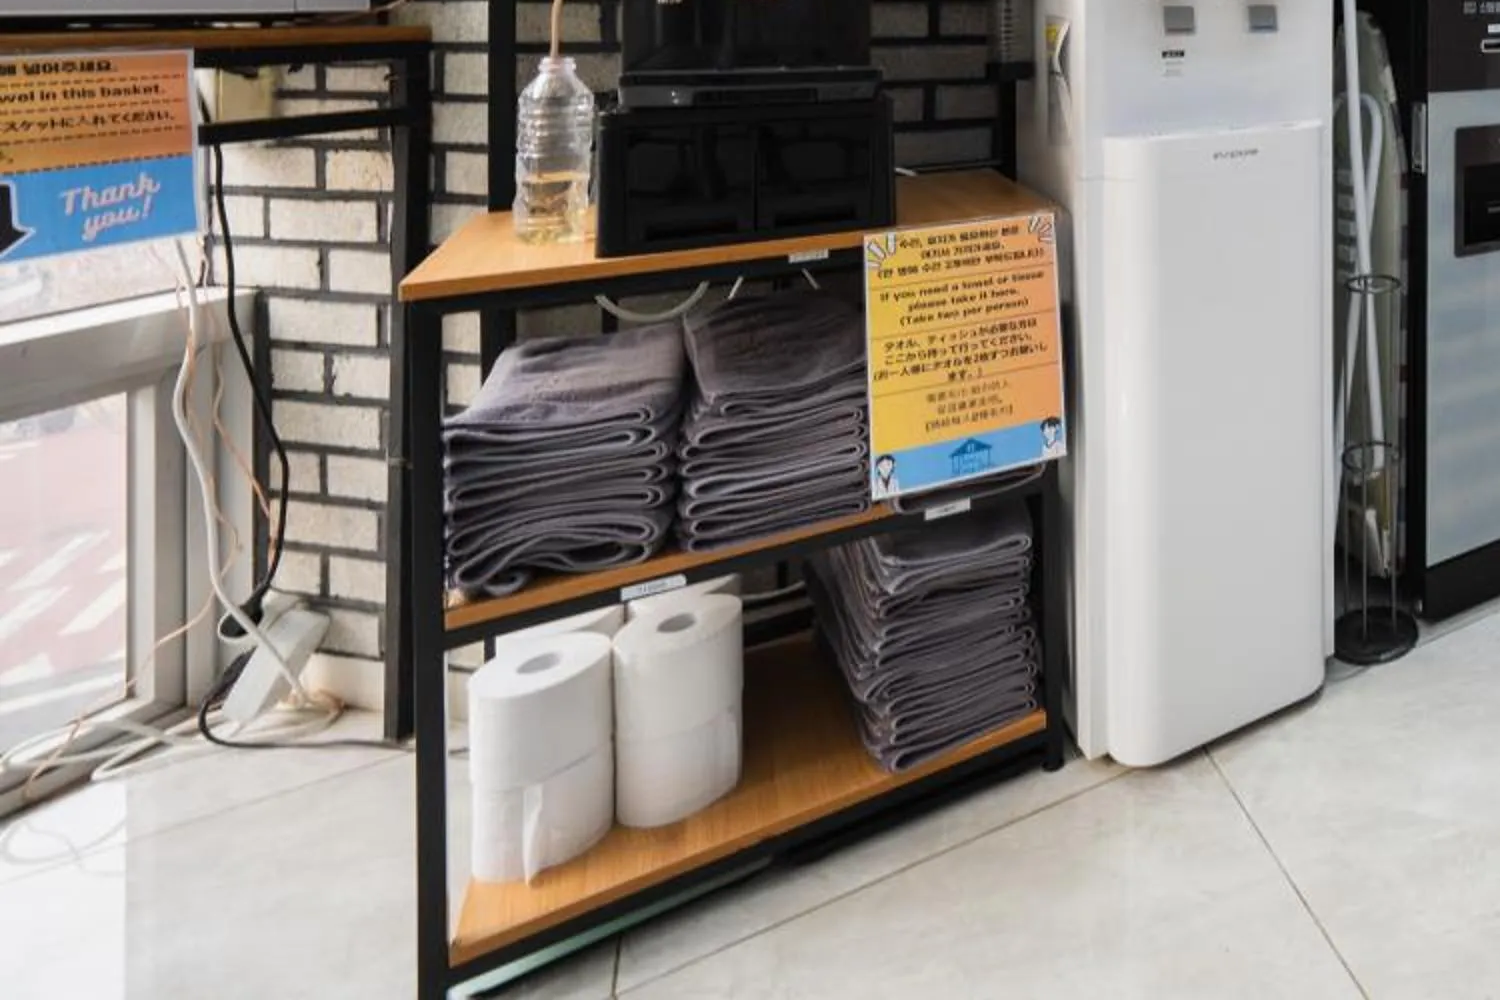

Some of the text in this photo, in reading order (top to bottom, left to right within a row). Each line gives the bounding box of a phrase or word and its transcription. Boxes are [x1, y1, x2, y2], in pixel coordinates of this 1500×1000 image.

[40, 89, 57, 101] in
[62, 86, 97, 100] this
[100, 83, 165, 99] basket.
[60, 171, 161, 216] Thank
[81, 195, 152, 242] you!
